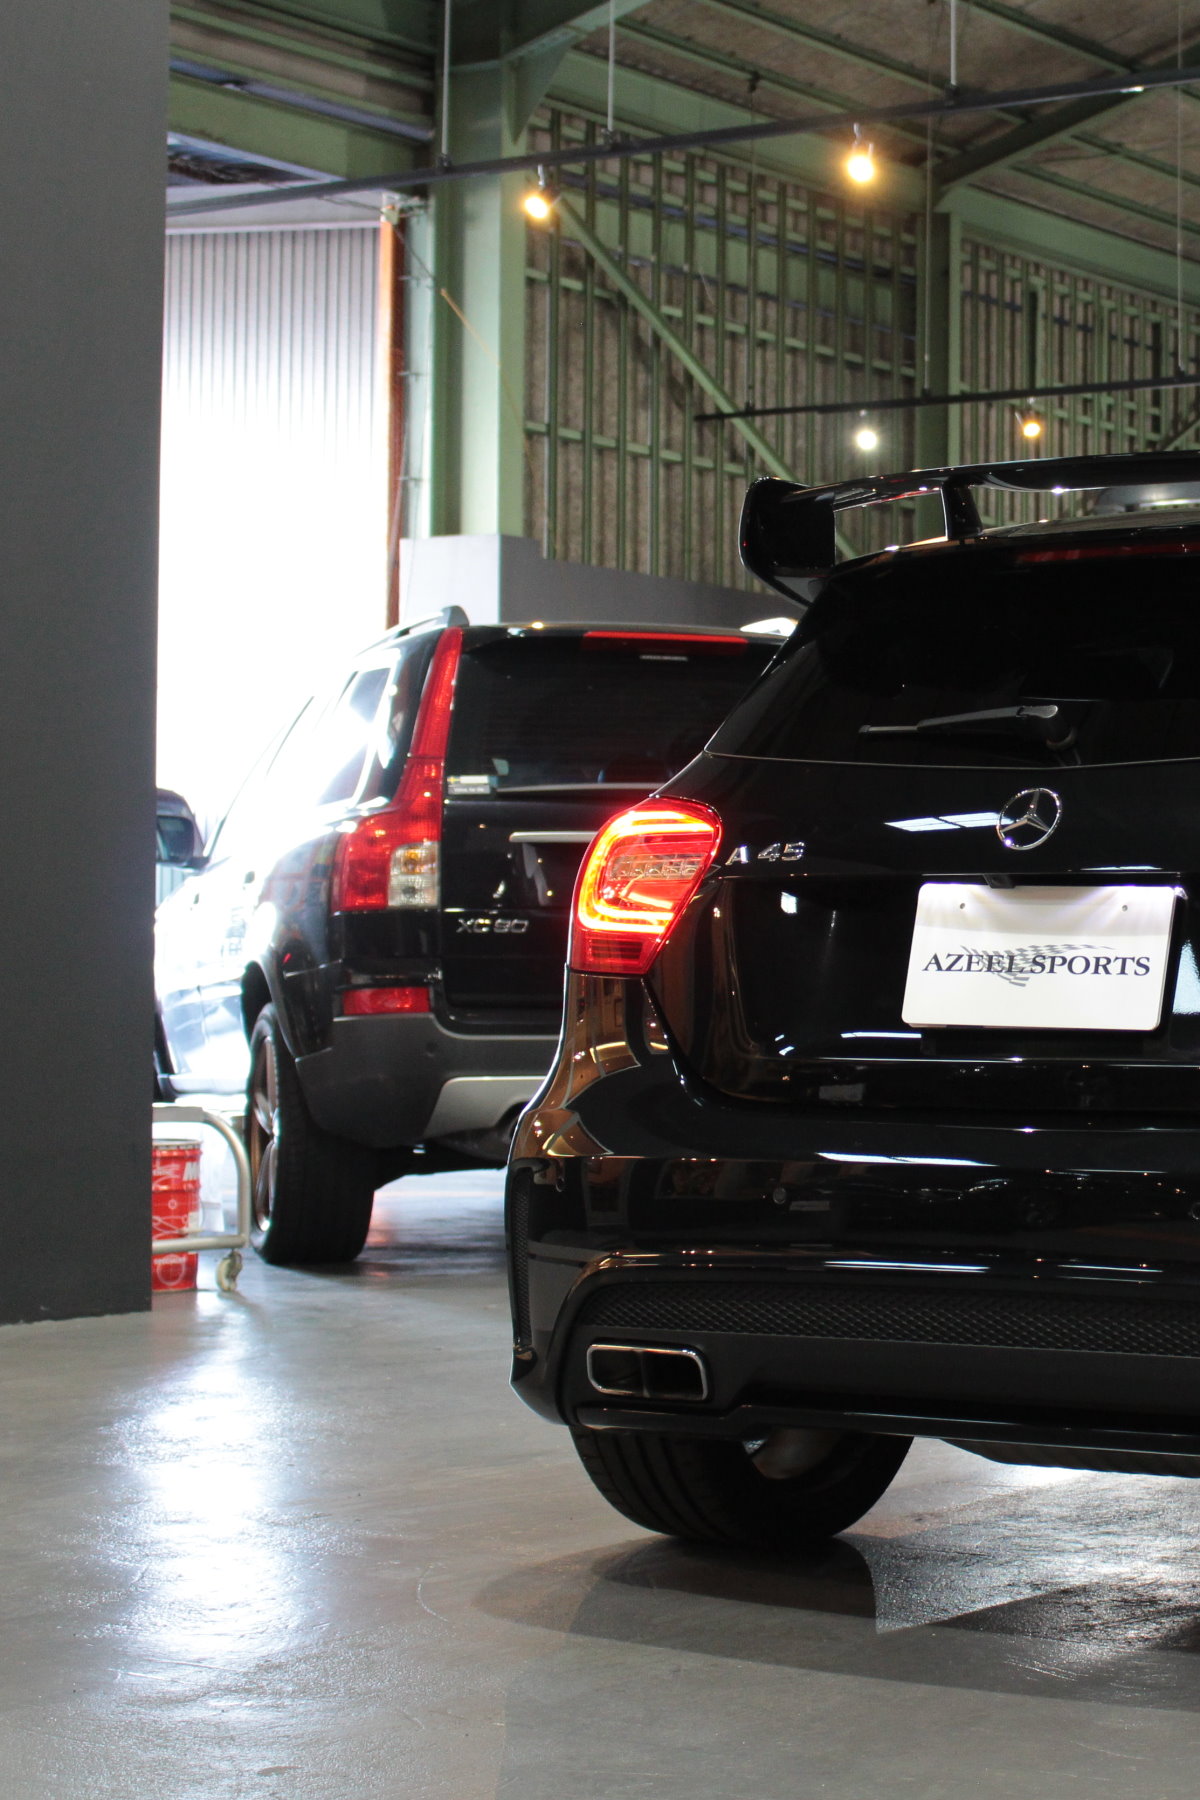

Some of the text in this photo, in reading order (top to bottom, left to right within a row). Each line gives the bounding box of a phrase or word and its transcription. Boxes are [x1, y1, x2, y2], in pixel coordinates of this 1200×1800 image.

[725, 841, 805, 865] A 45
[922, 952, 1151, 977] AZEEL SPORTS
